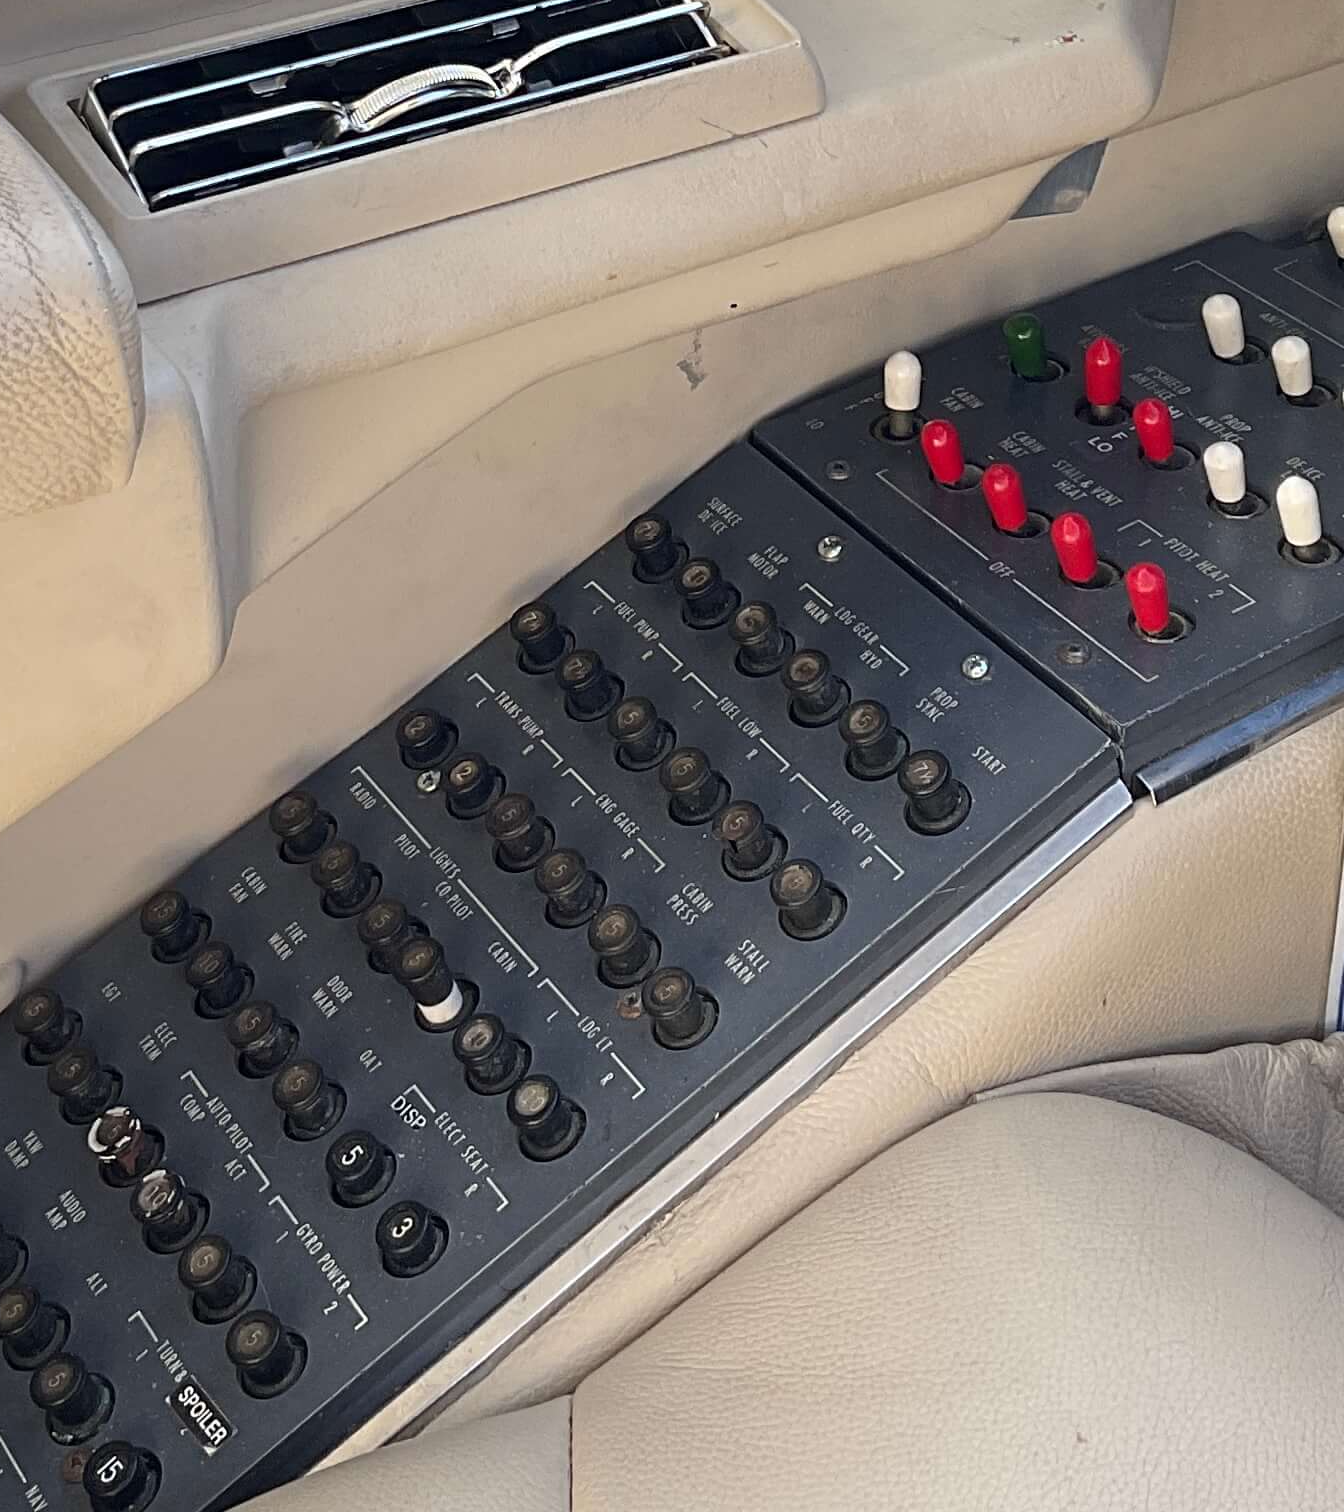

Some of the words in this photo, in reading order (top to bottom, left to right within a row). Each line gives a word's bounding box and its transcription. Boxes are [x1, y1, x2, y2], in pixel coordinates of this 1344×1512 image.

[971, 746, 1006, 776] START
[827, 800, 853, 825] FUEL
[850, 822, 876, 844] QTY
[724, 953, 756, 984] WARN
[738, 939, 771, 972] STALL
[206, 1096, 232, 1126] AUTO
[225, 1120, 253, 1155] PILOT
[391, 1096, 427, 1129] DISP
[178, 1386, 228, 1445] SPOILER
[97, 1456, 124, 1482] 15
